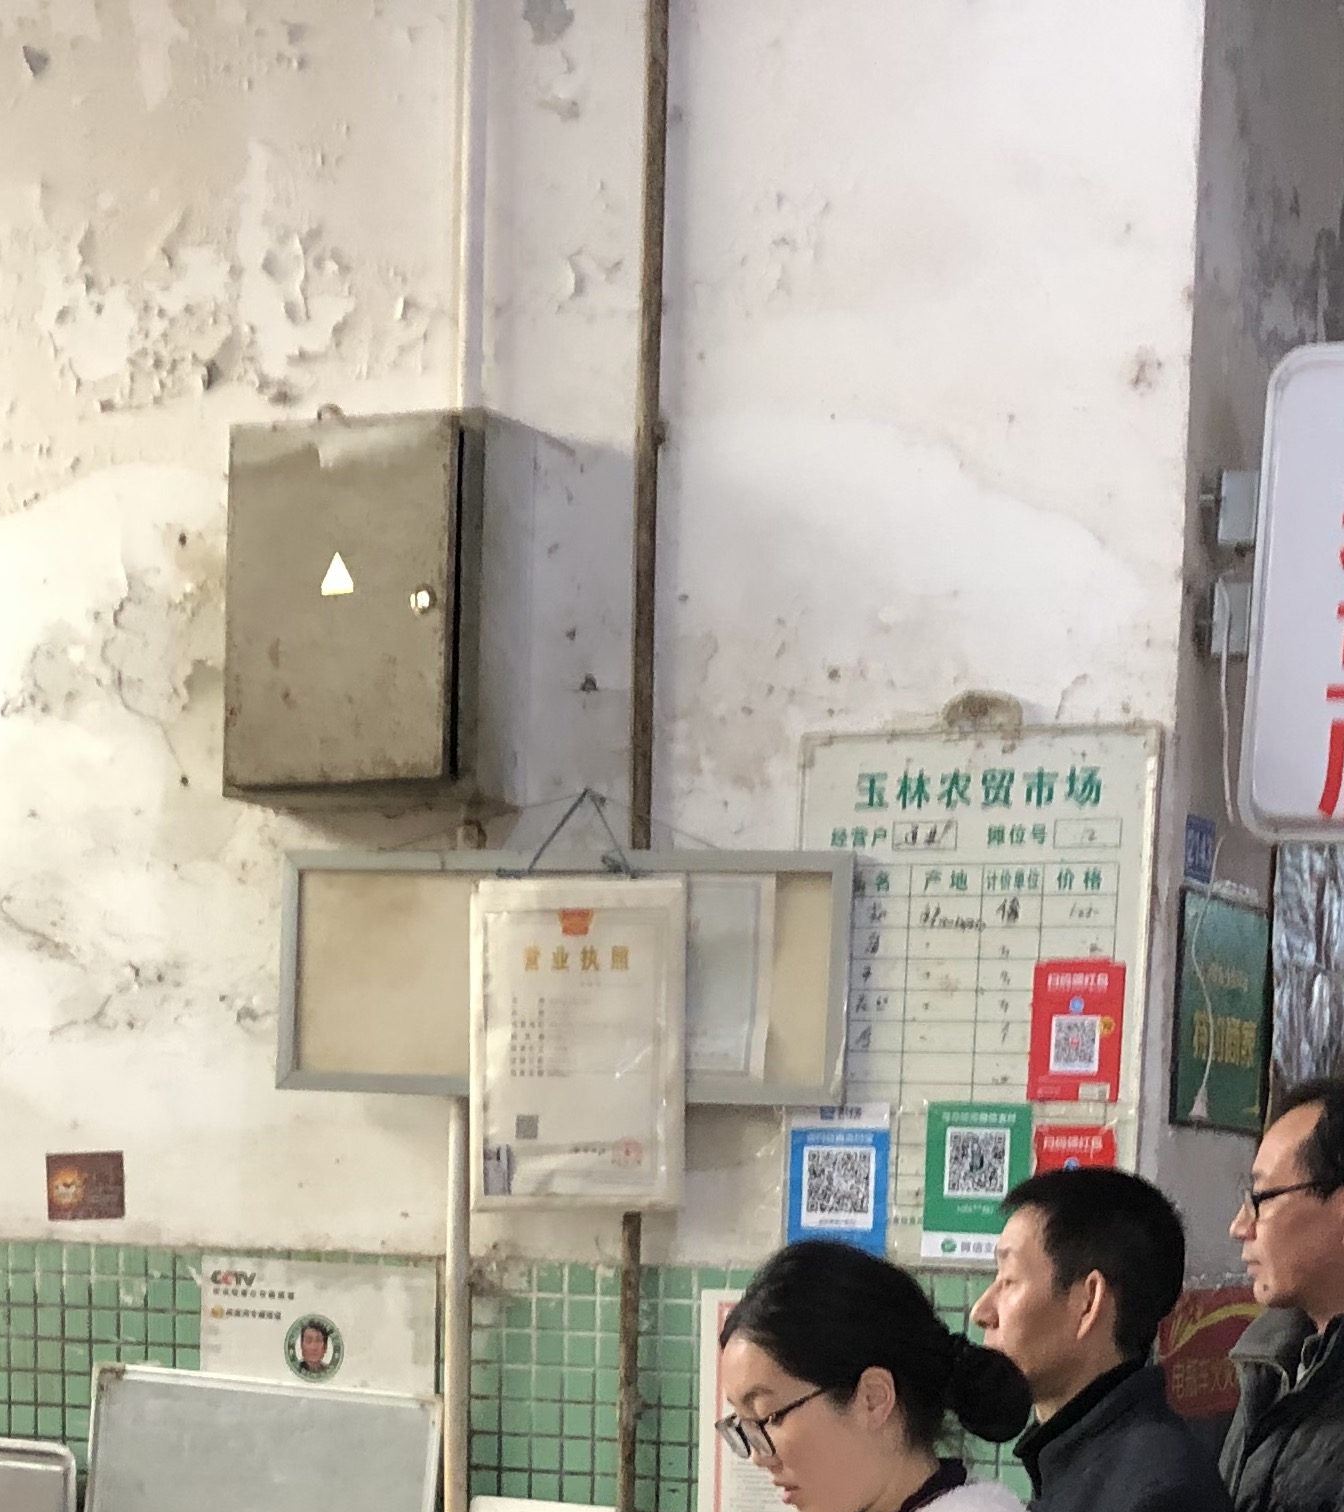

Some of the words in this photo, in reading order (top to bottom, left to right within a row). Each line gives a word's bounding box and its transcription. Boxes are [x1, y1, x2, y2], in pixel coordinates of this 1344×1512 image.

[854, 765, 1104, 811] 玉林农贸市场
[830, 826, 889, 848] 经营户
[987, 823, 1048, 847] 摊位号
[923, 869, 969, 893] 产地
[986, 867, 1040, 892] 计价单位
[1056, 867, 1103, 892] 价格
[523, 944, 630, 972] 营业执照
[211, 1269, 257, 1287] CCTV
